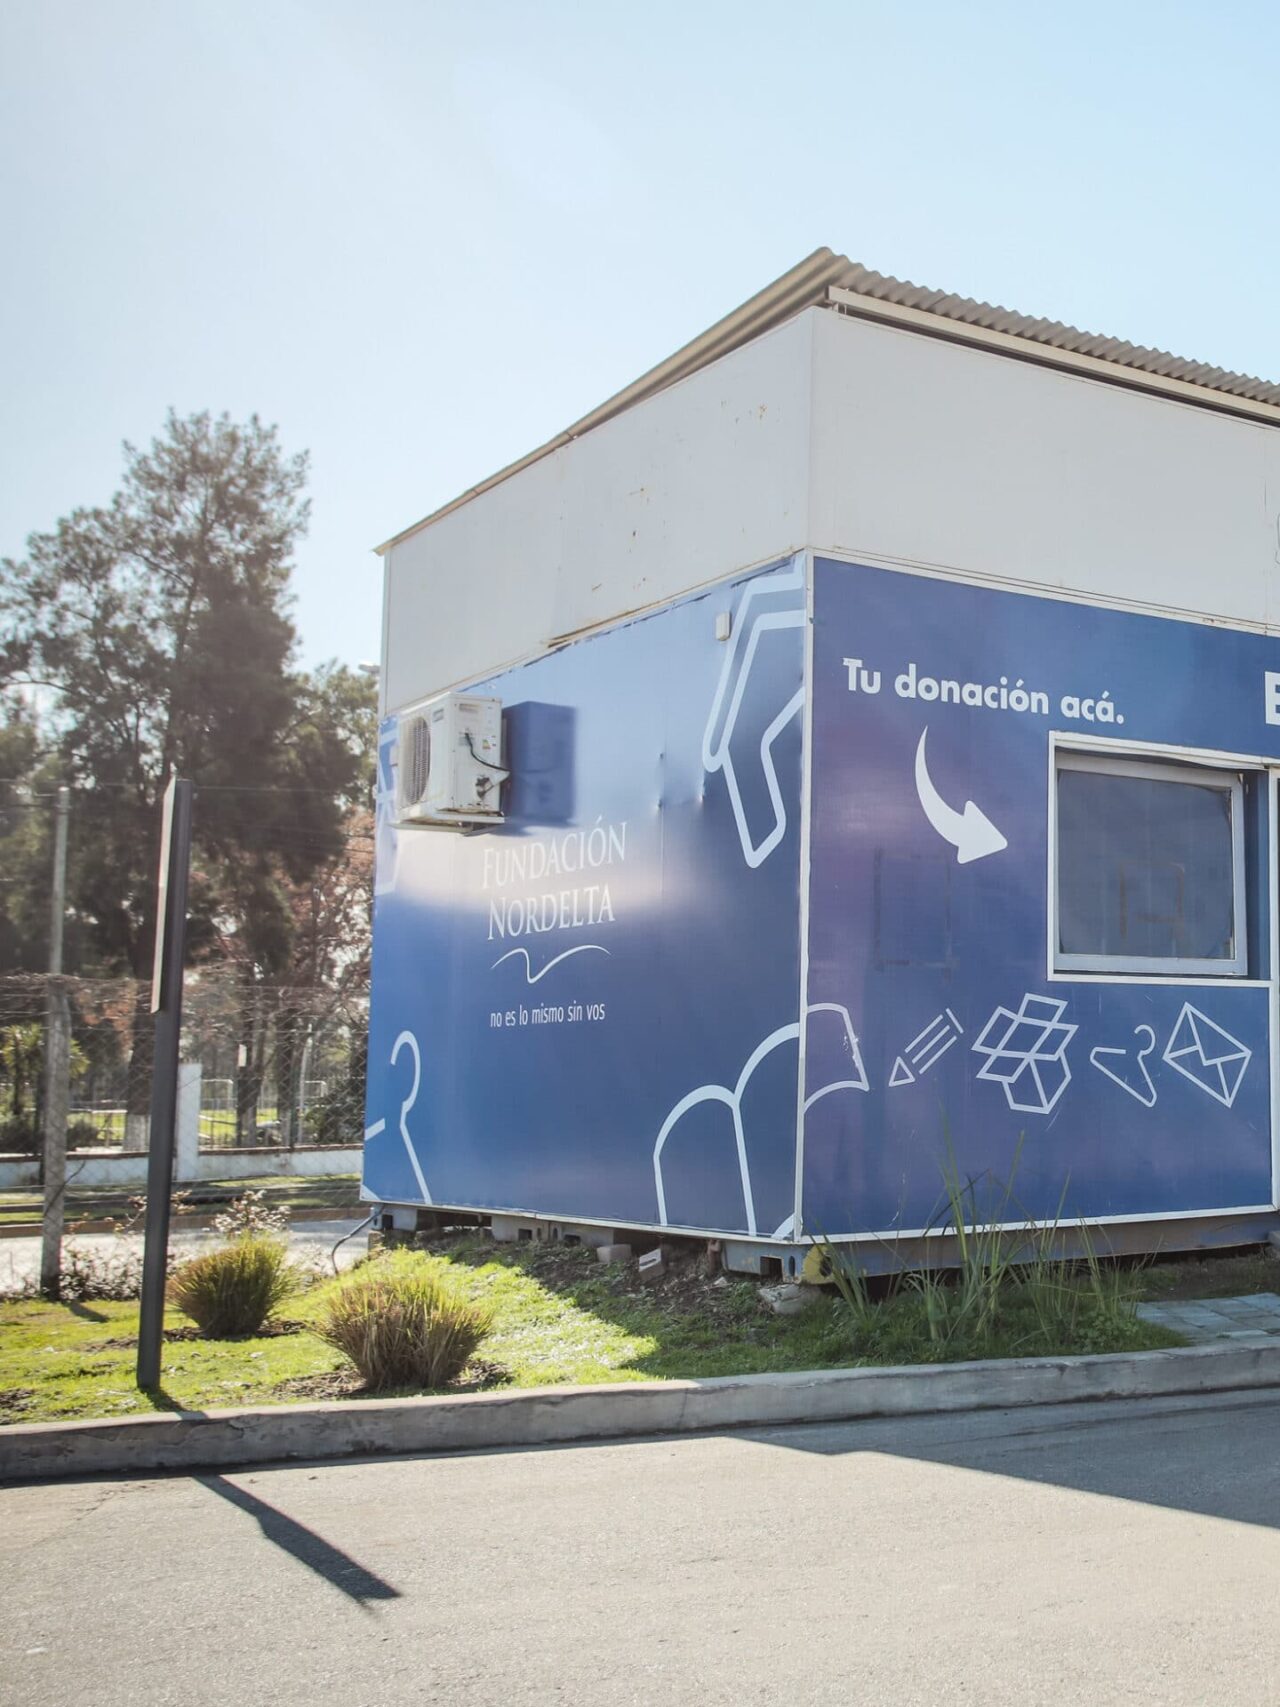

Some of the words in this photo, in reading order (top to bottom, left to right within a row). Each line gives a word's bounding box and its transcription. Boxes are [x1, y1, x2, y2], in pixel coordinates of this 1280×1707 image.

[842, 657, 881, 694] Tu
[894, 663, 1049, 715] donación
[1060, 690, 1125, 724] acá.
[482, 814, 628, 889] FUNDACIÓN
[487, 881, 616, 940] NORDELTA
[490, 1012, 502, 1027] no
[505, 1010, 516, 1026] es
[519, 1004, 528, 1025] lo
[531, 1002, 564, 1024] mismo
[567, 1000, 582, 1021] sin
[586, 1003, 606, 1021] vos
